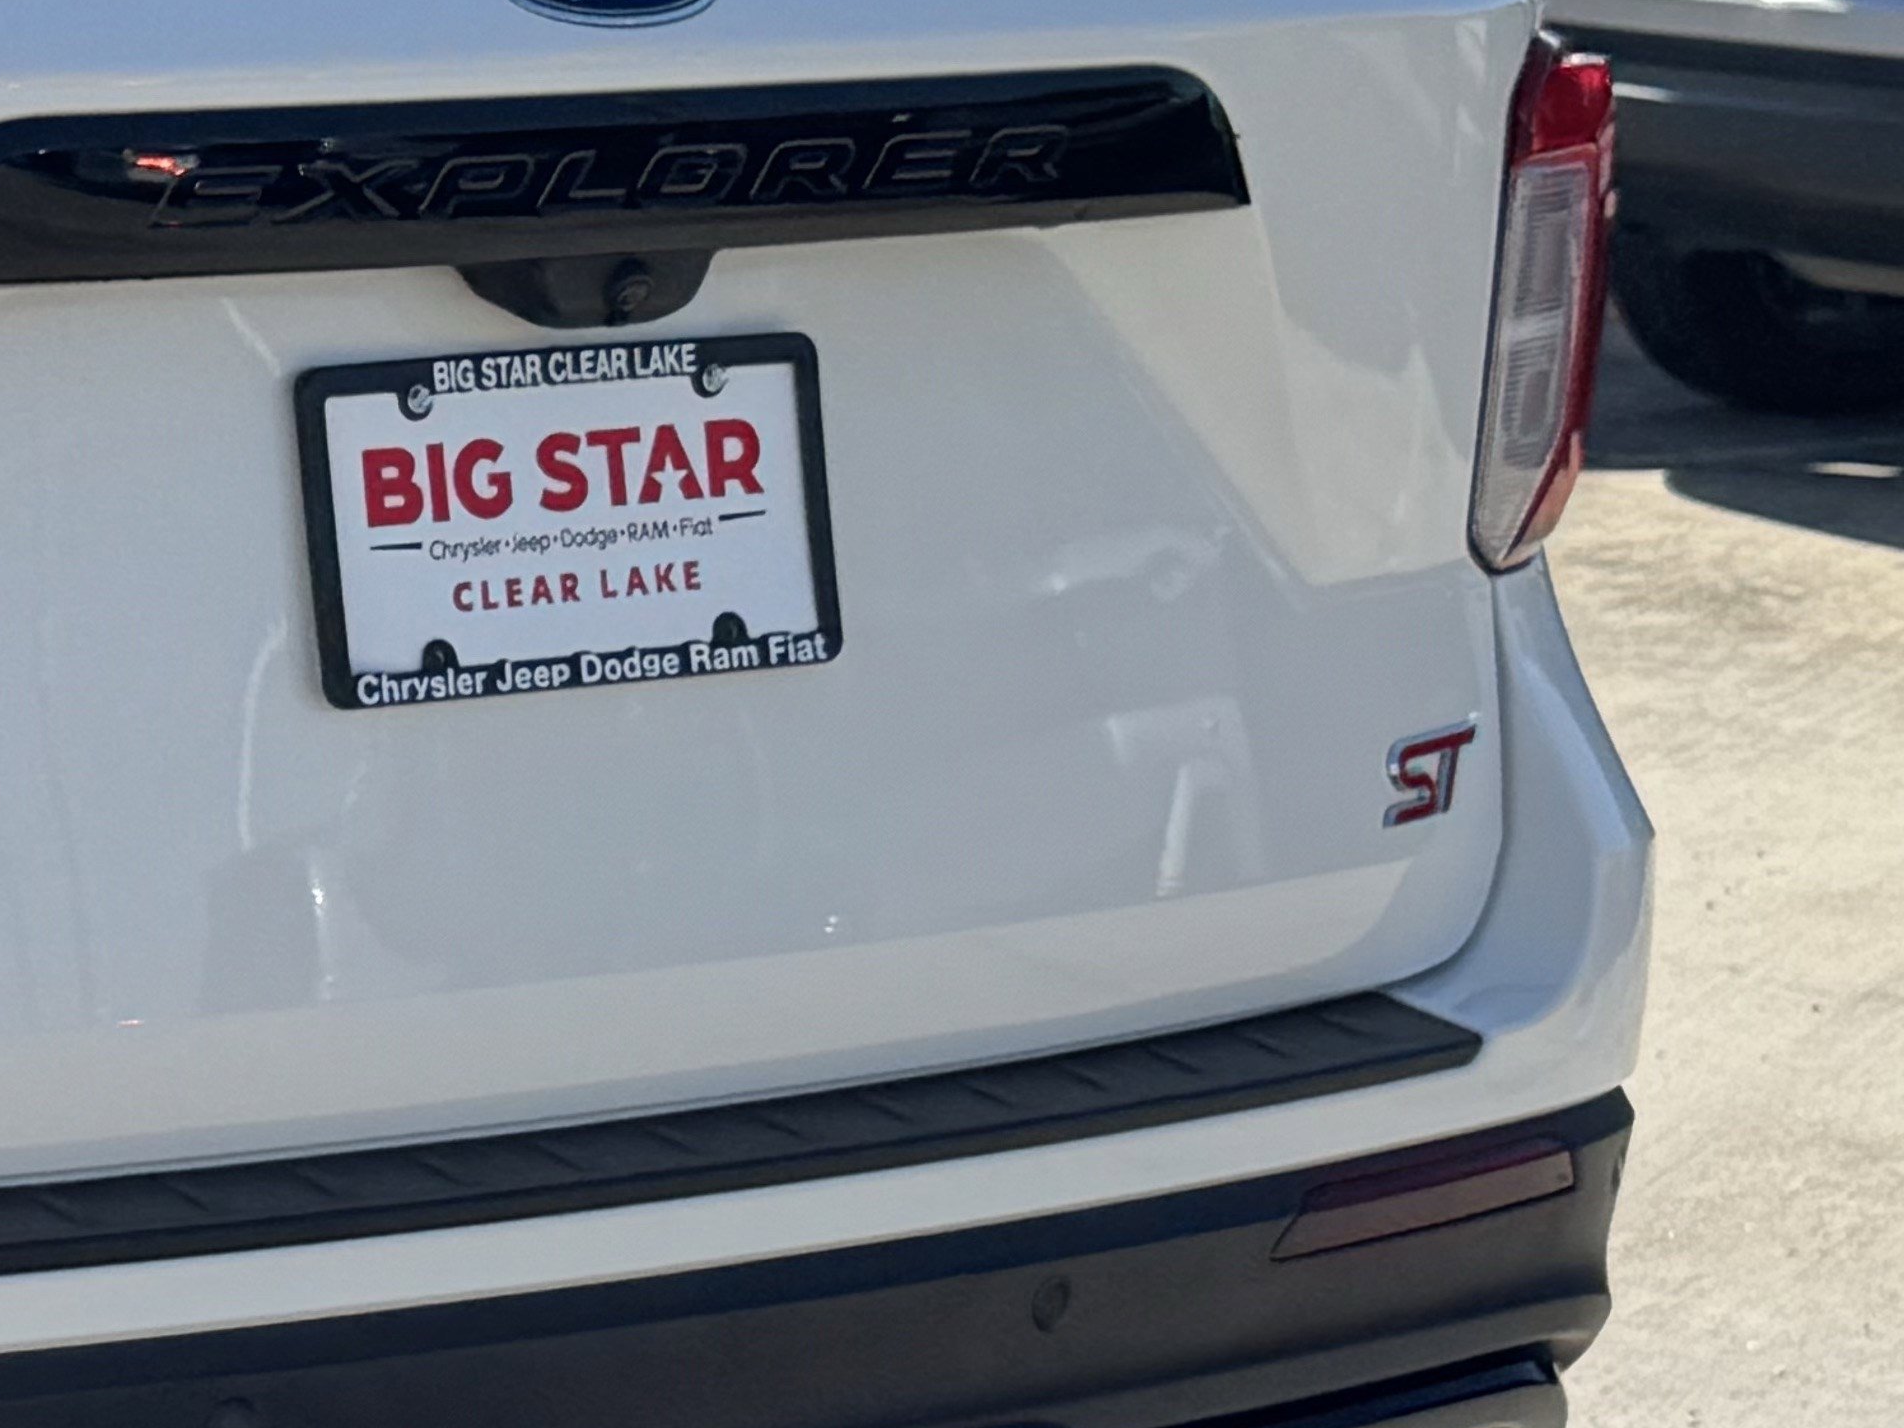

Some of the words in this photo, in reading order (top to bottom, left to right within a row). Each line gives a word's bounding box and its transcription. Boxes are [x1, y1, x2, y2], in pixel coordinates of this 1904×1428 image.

[149, 124, 1069, 228] EXPLORER
[432, 359, 475, 393] BIG
[480, 353, 542, 388] STAR
[548, 347, 629, 383] CLEAR
[633, 342, 698, 376] LAKE
[361, 438, 514, 528] BIG
[535, 418, 765, 513] STAR
[451, 572, 581, 613] CLEAR
[599, 560, 702, 599] LAKE
[356, 668, 489, 706] Chrysler
[495, 658, 572, 693] Jeep
[579, 645, 681, 682] Dodge
[690, 642, 761, 673] Ram
[767, 631, 829, 664] Fiat
[1382, 720, 1478, 829] ST
